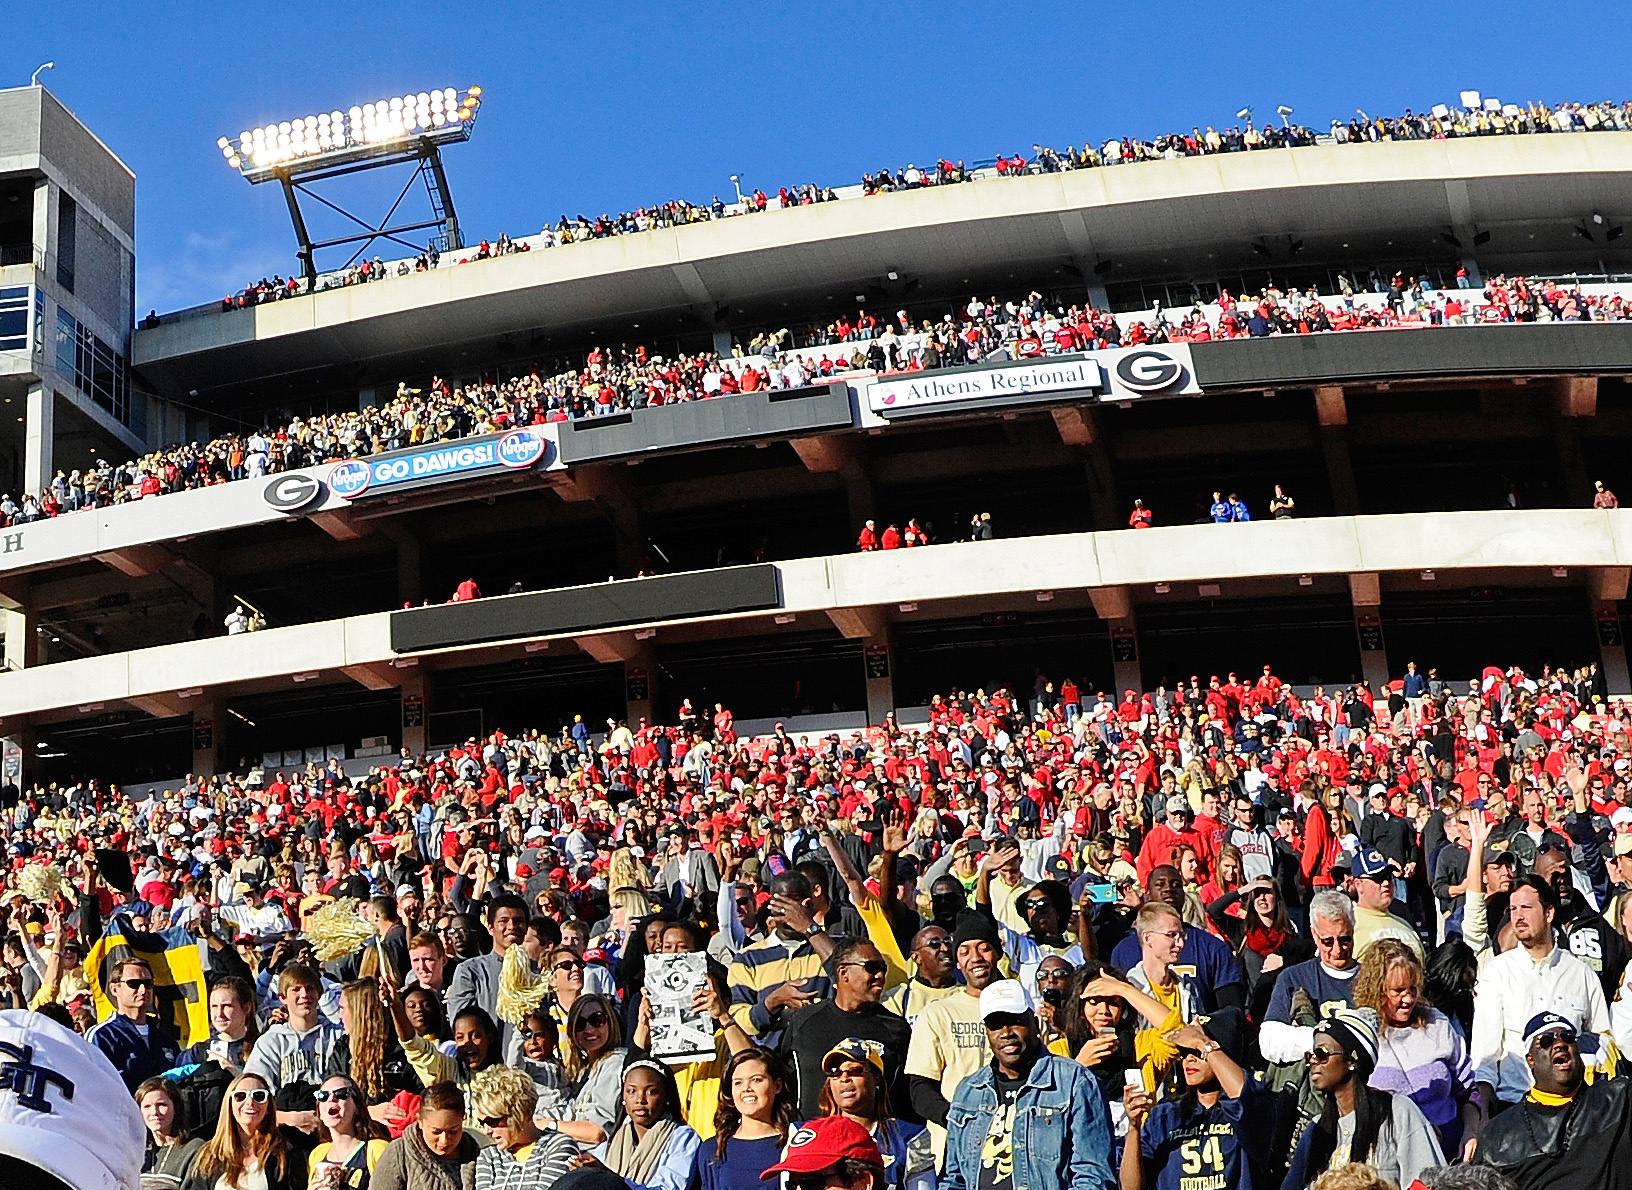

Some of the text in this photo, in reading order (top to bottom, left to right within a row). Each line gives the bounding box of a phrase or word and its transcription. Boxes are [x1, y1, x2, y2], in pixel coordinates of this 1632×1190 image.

[906, 364, 1086, 401] Athens Regional
[375, 445, 493, 482] GO DAWGS!
[502, 436, 541, 461] Kroger
[332, 466, 370, 490] Kroger
[1180, 1135, 1225, 1175] 54
